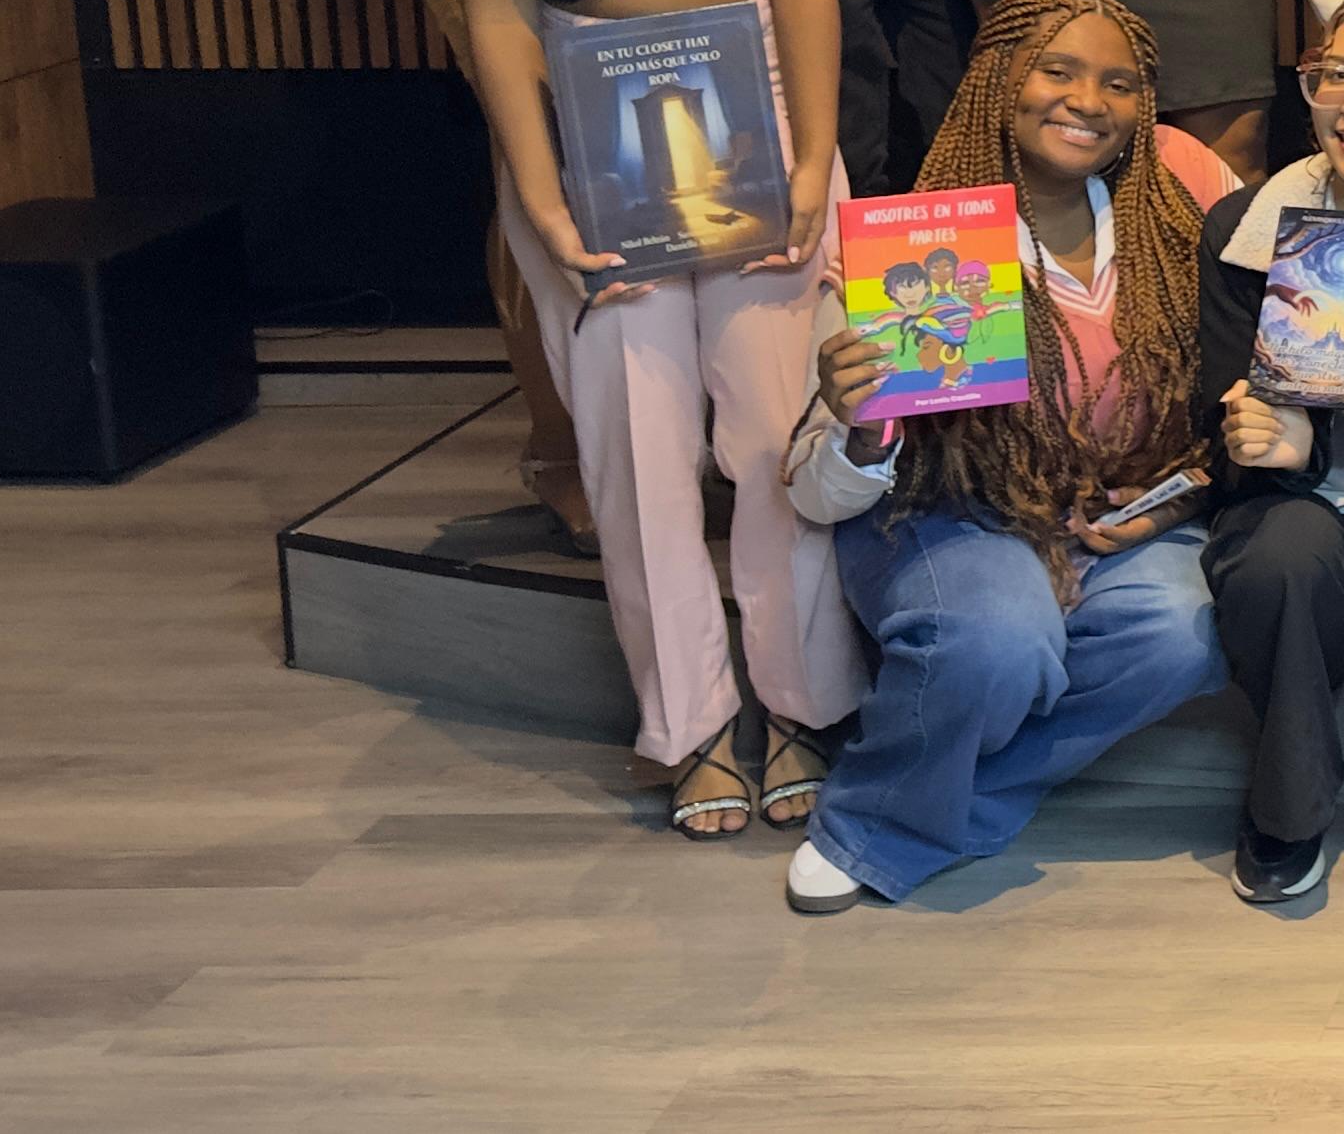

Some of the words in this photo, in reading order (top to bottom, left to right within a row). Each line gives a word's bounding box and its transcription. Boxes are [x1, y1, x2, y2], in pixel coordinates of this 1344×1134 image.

[597, 48, 615, 63] EN
[616, 46, 634, 61] TU
[635, 39, 683, 57] CLOSET
[685, 35, 711, 49] HAY
[601, 63, 635, 78] ALGO
[636, 58, 662, 74] MÁS
[663, 55, 687, 70] QUE
[689, 49, 721, 65] SOLO
[648, 72, 681, 87] ROPA
[863, 205, 929, 225] NOSOTRES
[933, 203, 952, 220] EN
[957, 198, 996, 217] TODAS
[908, 226, 958, 246] PARTES
